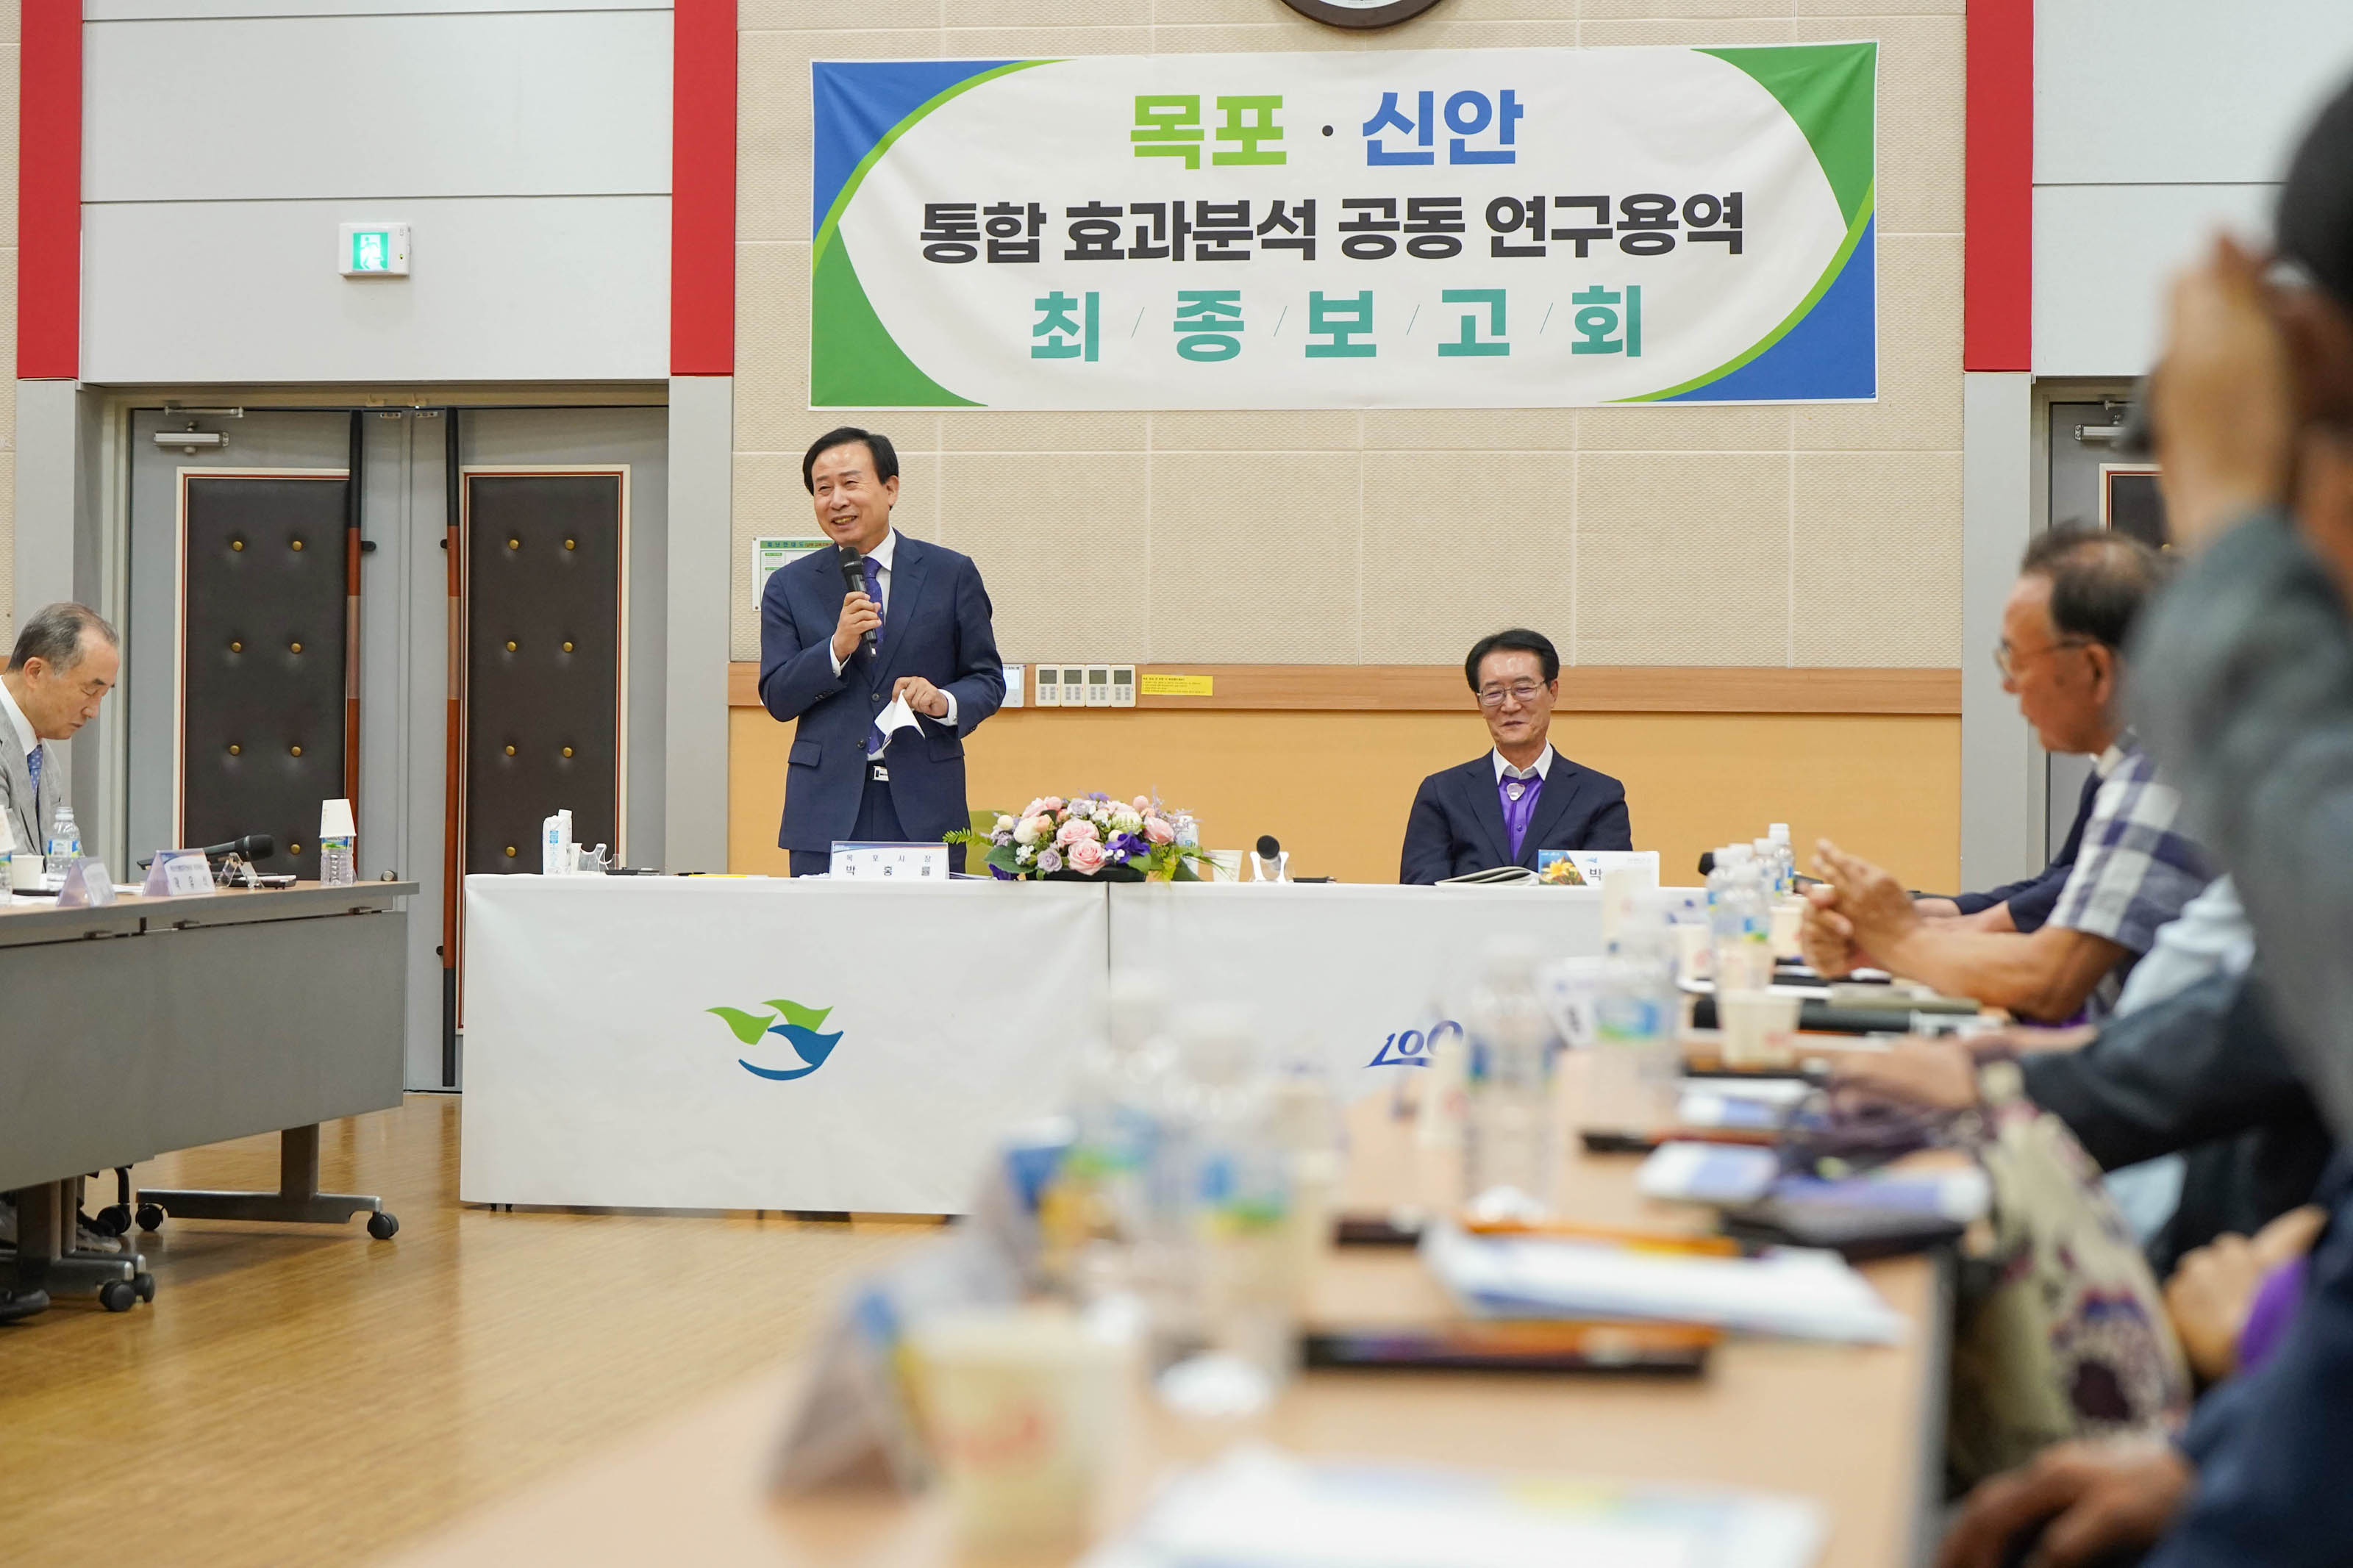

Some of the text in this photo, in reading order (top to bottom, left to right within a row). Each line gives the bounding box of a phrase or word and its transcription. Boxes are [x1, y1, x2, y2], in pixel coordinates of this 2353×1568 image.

[1131, 95, 1286, 170] 목포
[1363, 90, 1523, 165] 신안
[921, 192, 1742, 263] 통합 효과분석 공동 연구용역
